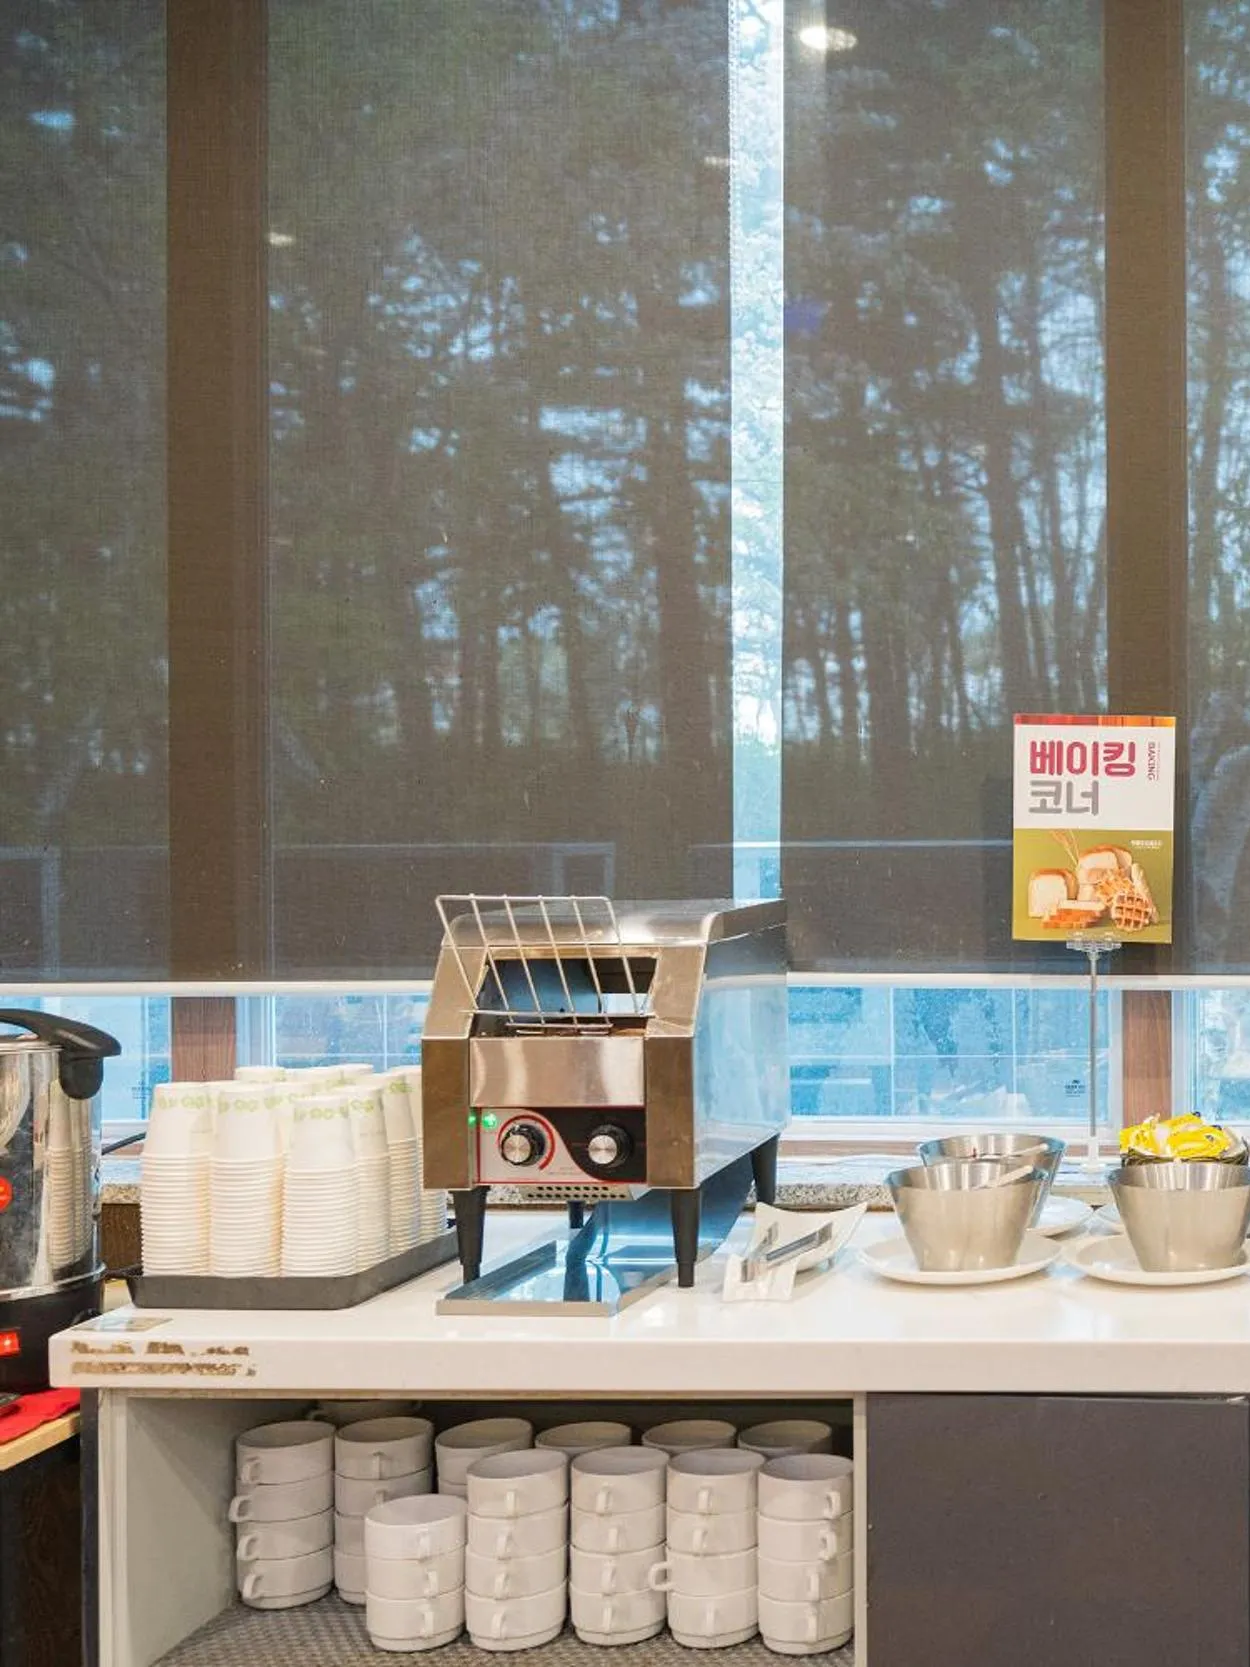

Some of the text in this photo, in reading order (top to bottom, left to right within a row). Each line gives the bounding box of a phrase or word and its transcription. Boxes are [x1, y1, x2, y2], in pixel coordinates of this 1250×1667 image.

[1029, 741, 1136, 777] 베이킹
[1147, 741, 1157, 781] BAKING
[1029, 780, 1100, 816] 코너
